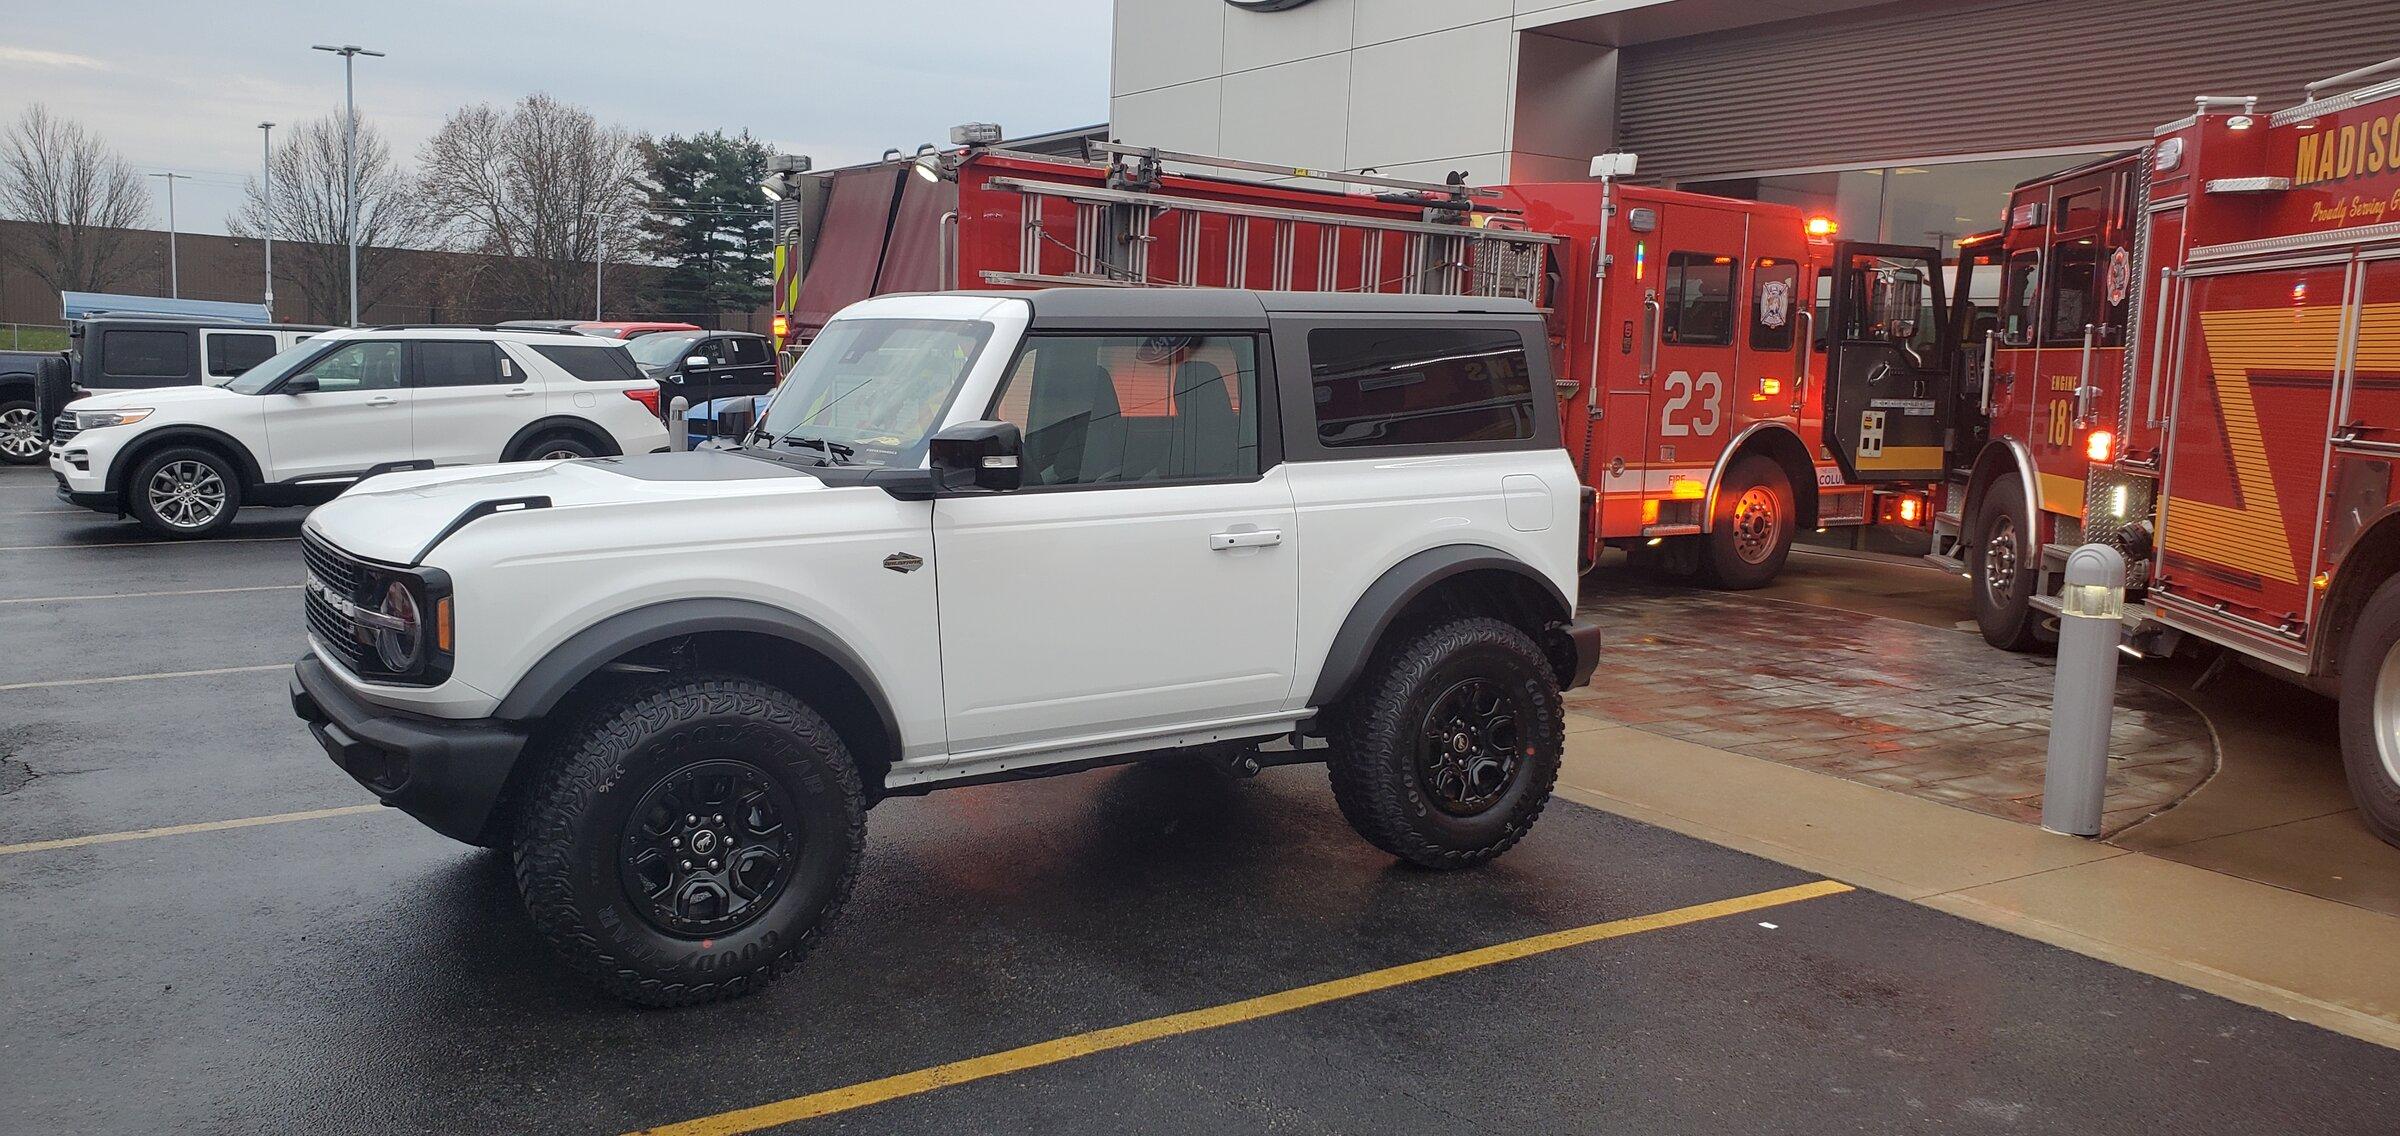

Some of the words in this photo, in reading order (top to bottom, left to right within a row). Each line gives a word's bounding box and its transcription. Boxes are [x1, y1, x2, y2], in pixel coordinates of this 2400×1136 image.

[2311, 198, 2347, 228] Proudly
[2350, 196, 2386, 222] Serving
[2051, 375, 2078, 391] ENGINE
[1661, 371, 1722, 436] 23
[2048, 399, 2074, 447] 181
[1820, 475, 1843, 485] COLU
